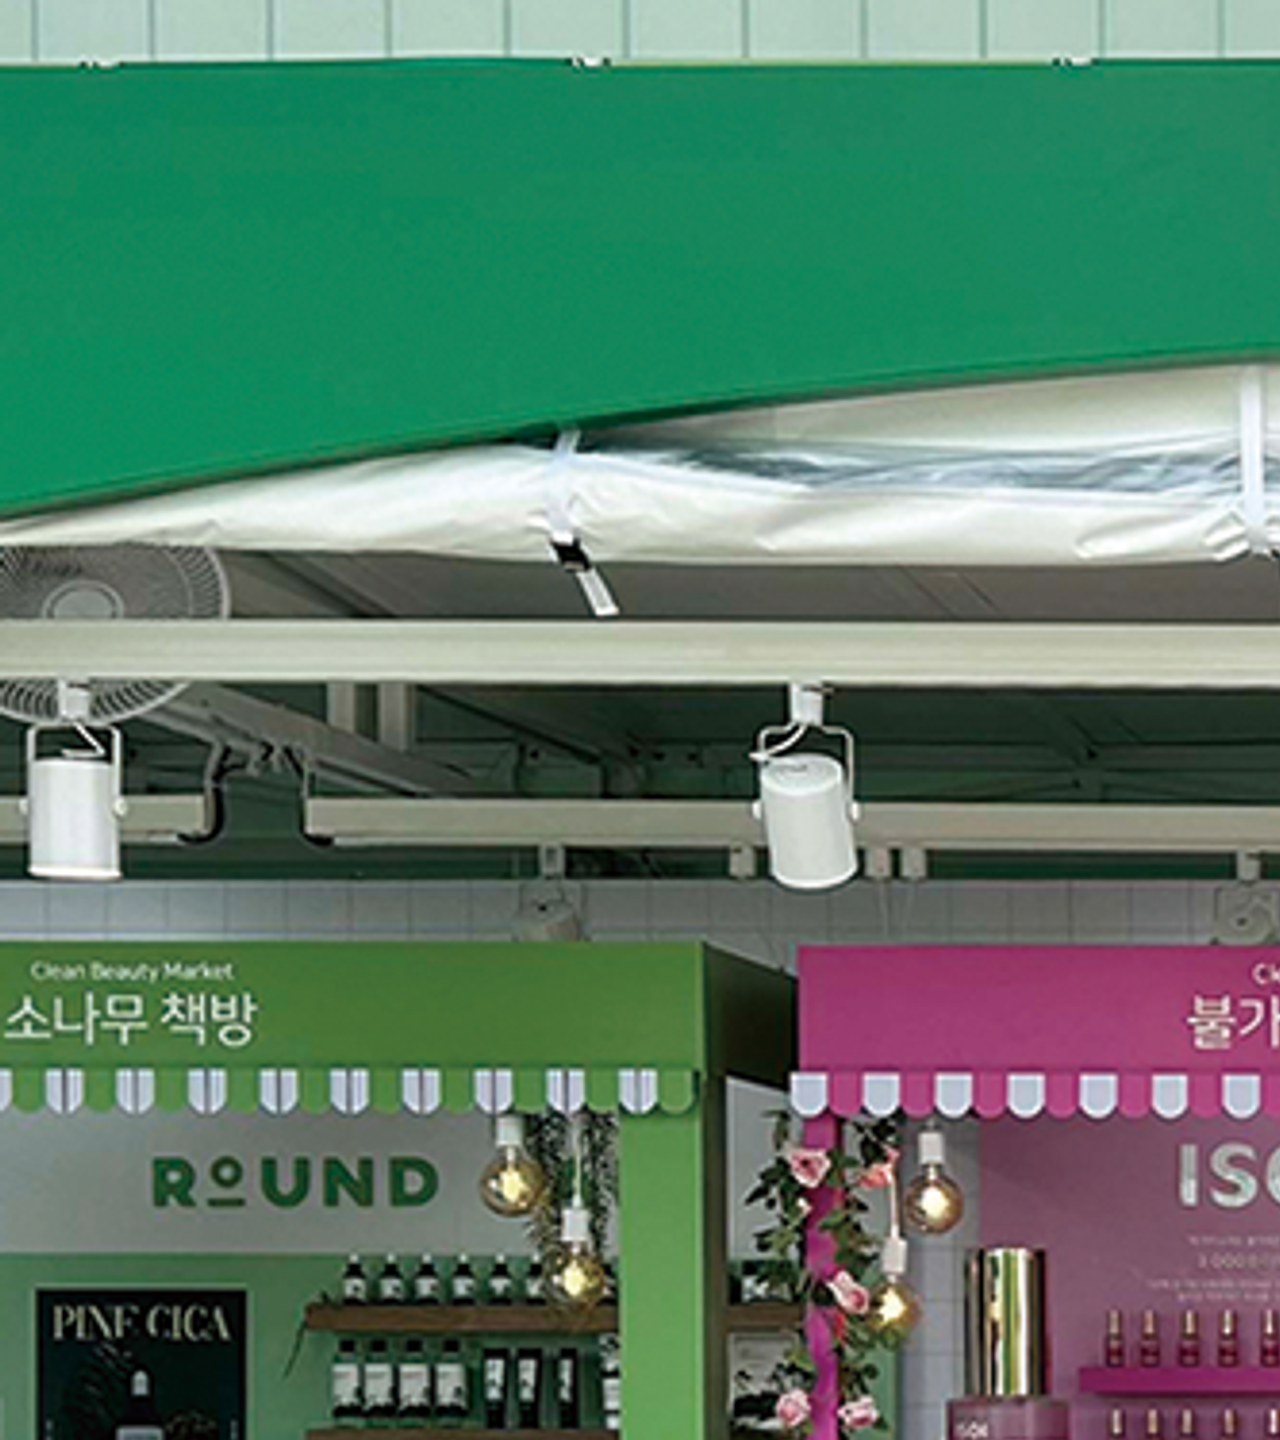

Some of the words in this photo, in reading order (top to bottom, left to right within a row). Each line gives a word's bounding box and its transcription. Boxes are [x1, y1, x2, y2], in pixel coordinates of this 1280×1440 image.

[30, 961, 86, 980] Clean
[91, 961, 158, 983] Beauty
[163, 961, 235, 980] Market
[4, 991, 148, 1046] 소나무
[160, 992, 260, 1047] 책방
[145, 1305, 231, 1342] CICA
